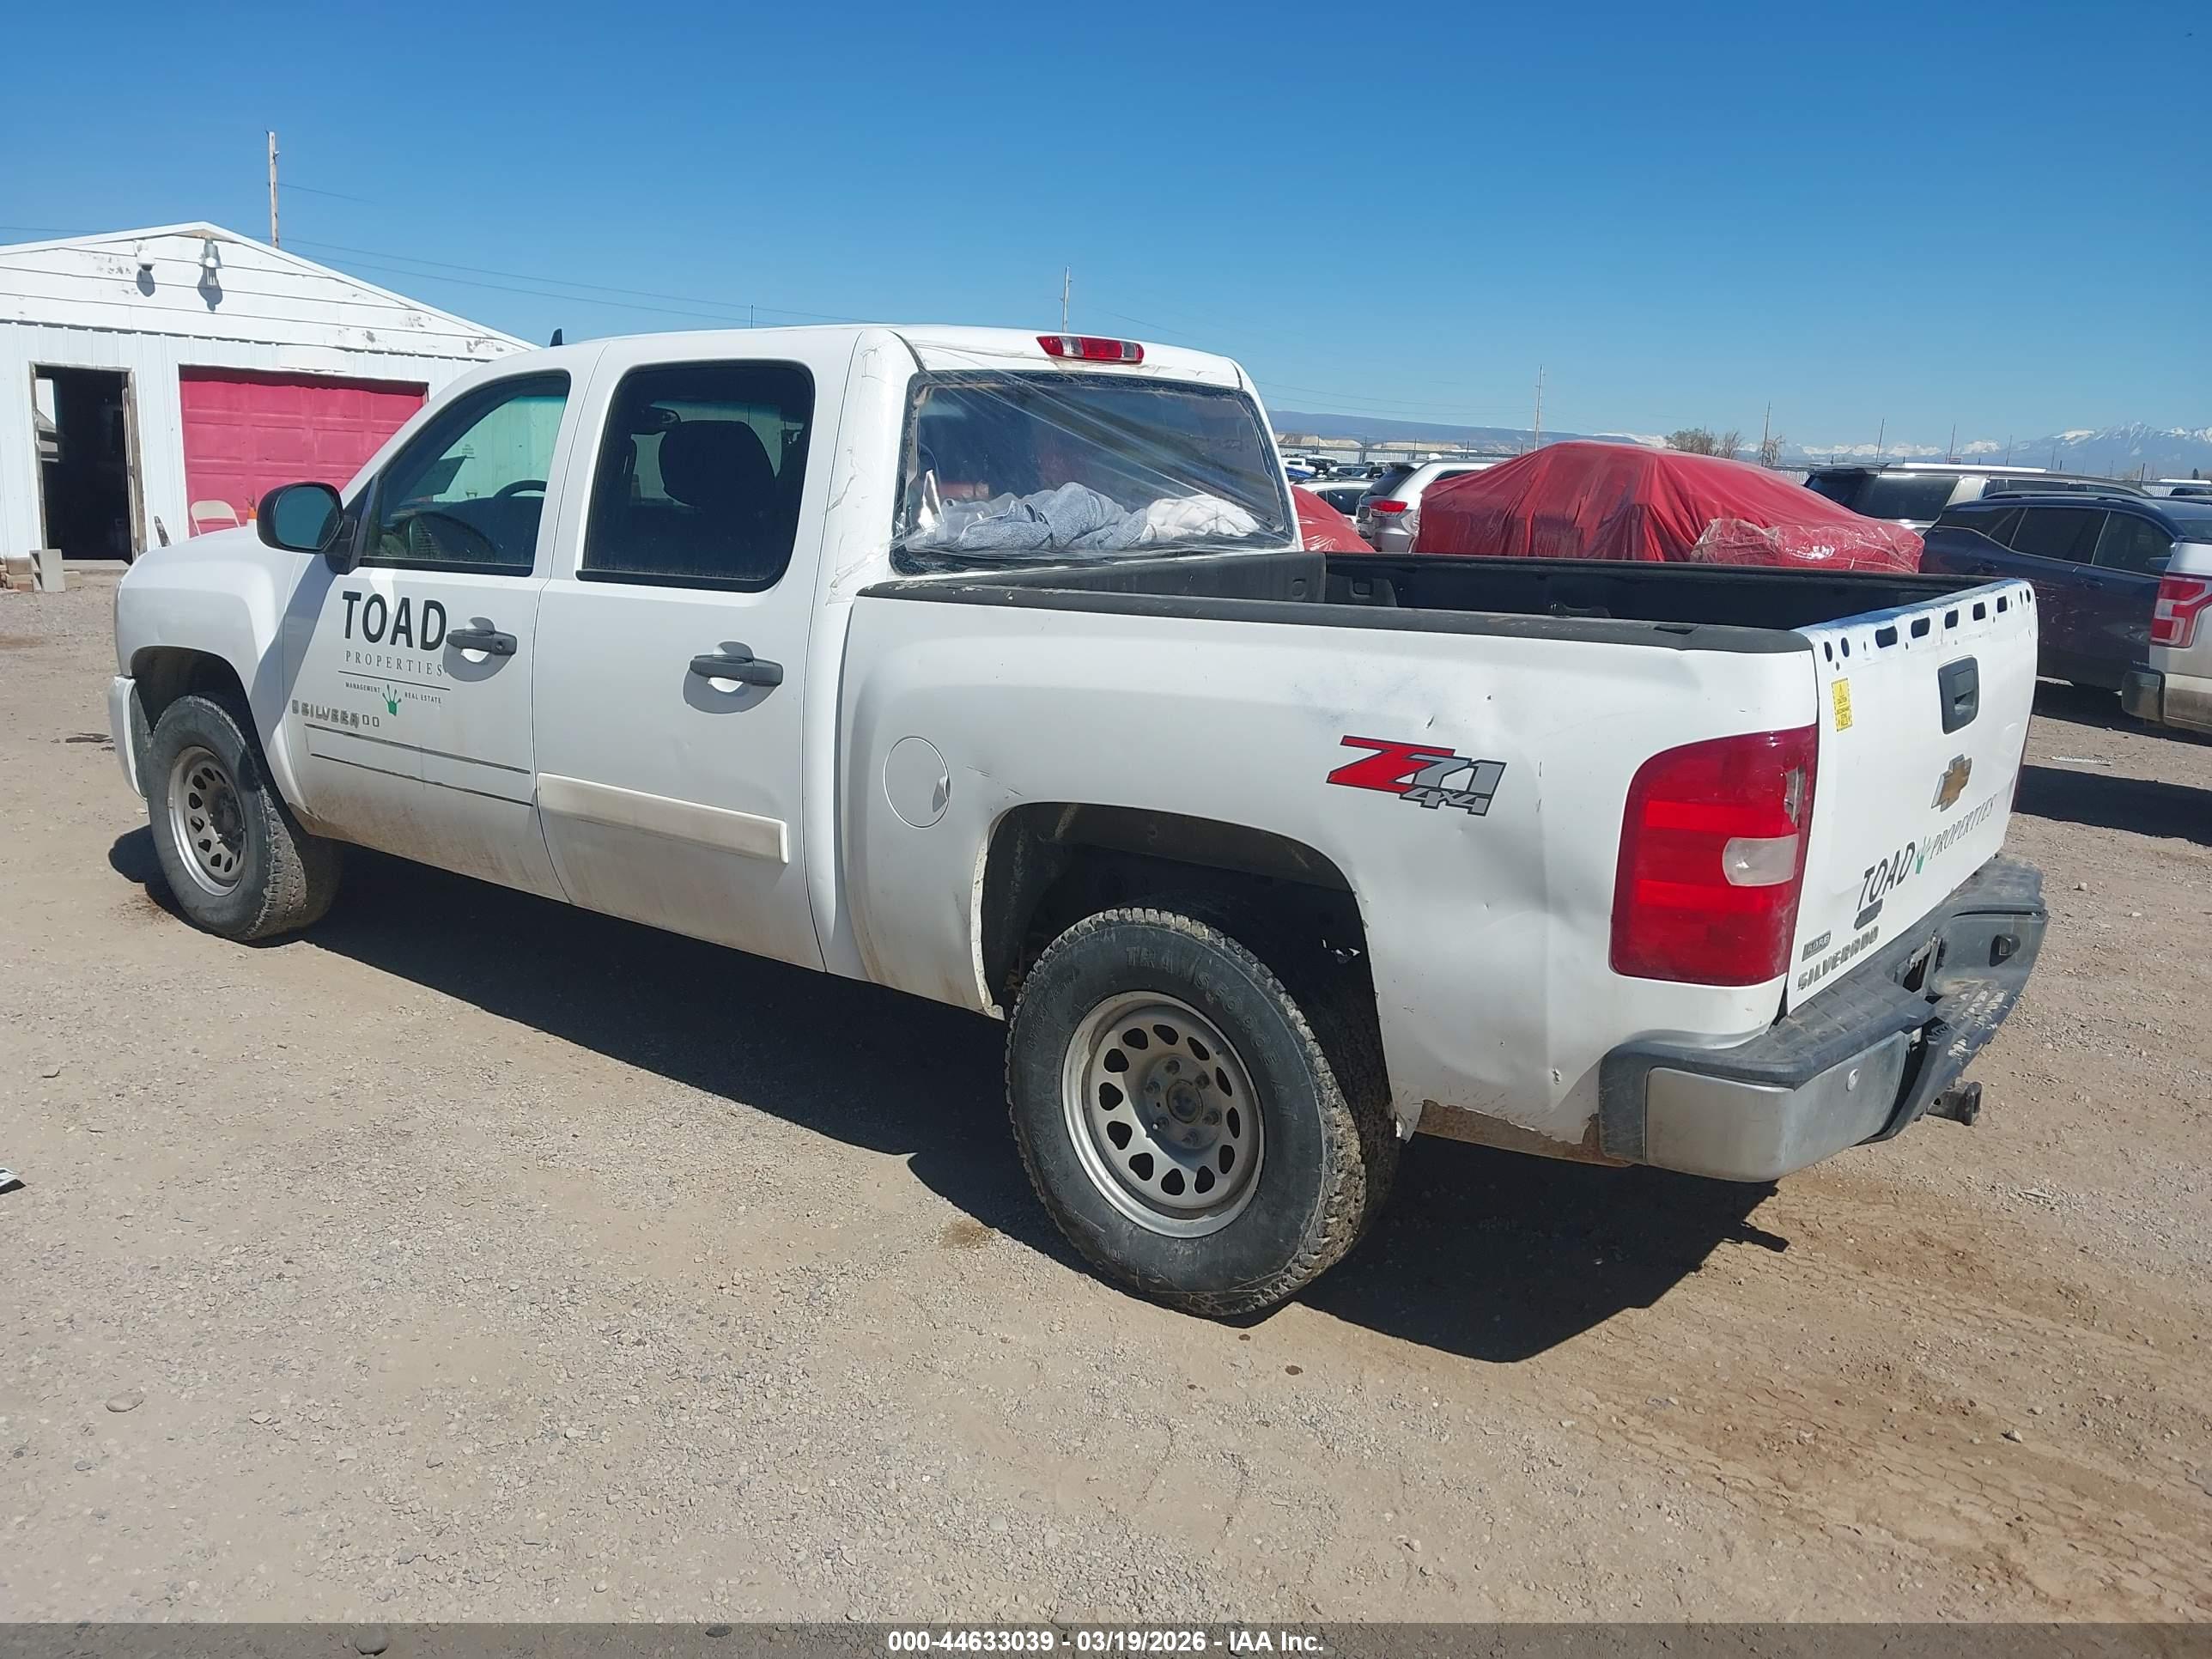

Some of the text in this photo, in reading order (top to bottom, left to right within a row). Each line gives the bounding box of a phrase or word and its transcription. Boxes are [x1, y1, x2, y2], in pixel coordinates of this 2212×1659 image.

[343, 591, 447, 651] TOAD
[345, 650, 443, 677] PROPERTIES
[345, 682, 380, 693] MANAGEMENT
[404, 691, 441, 704] REAL ESTATE
[1326, 735, 1507, 799] Z71
[1857, 793, 1997, 912] TOAD PROPERTIES
